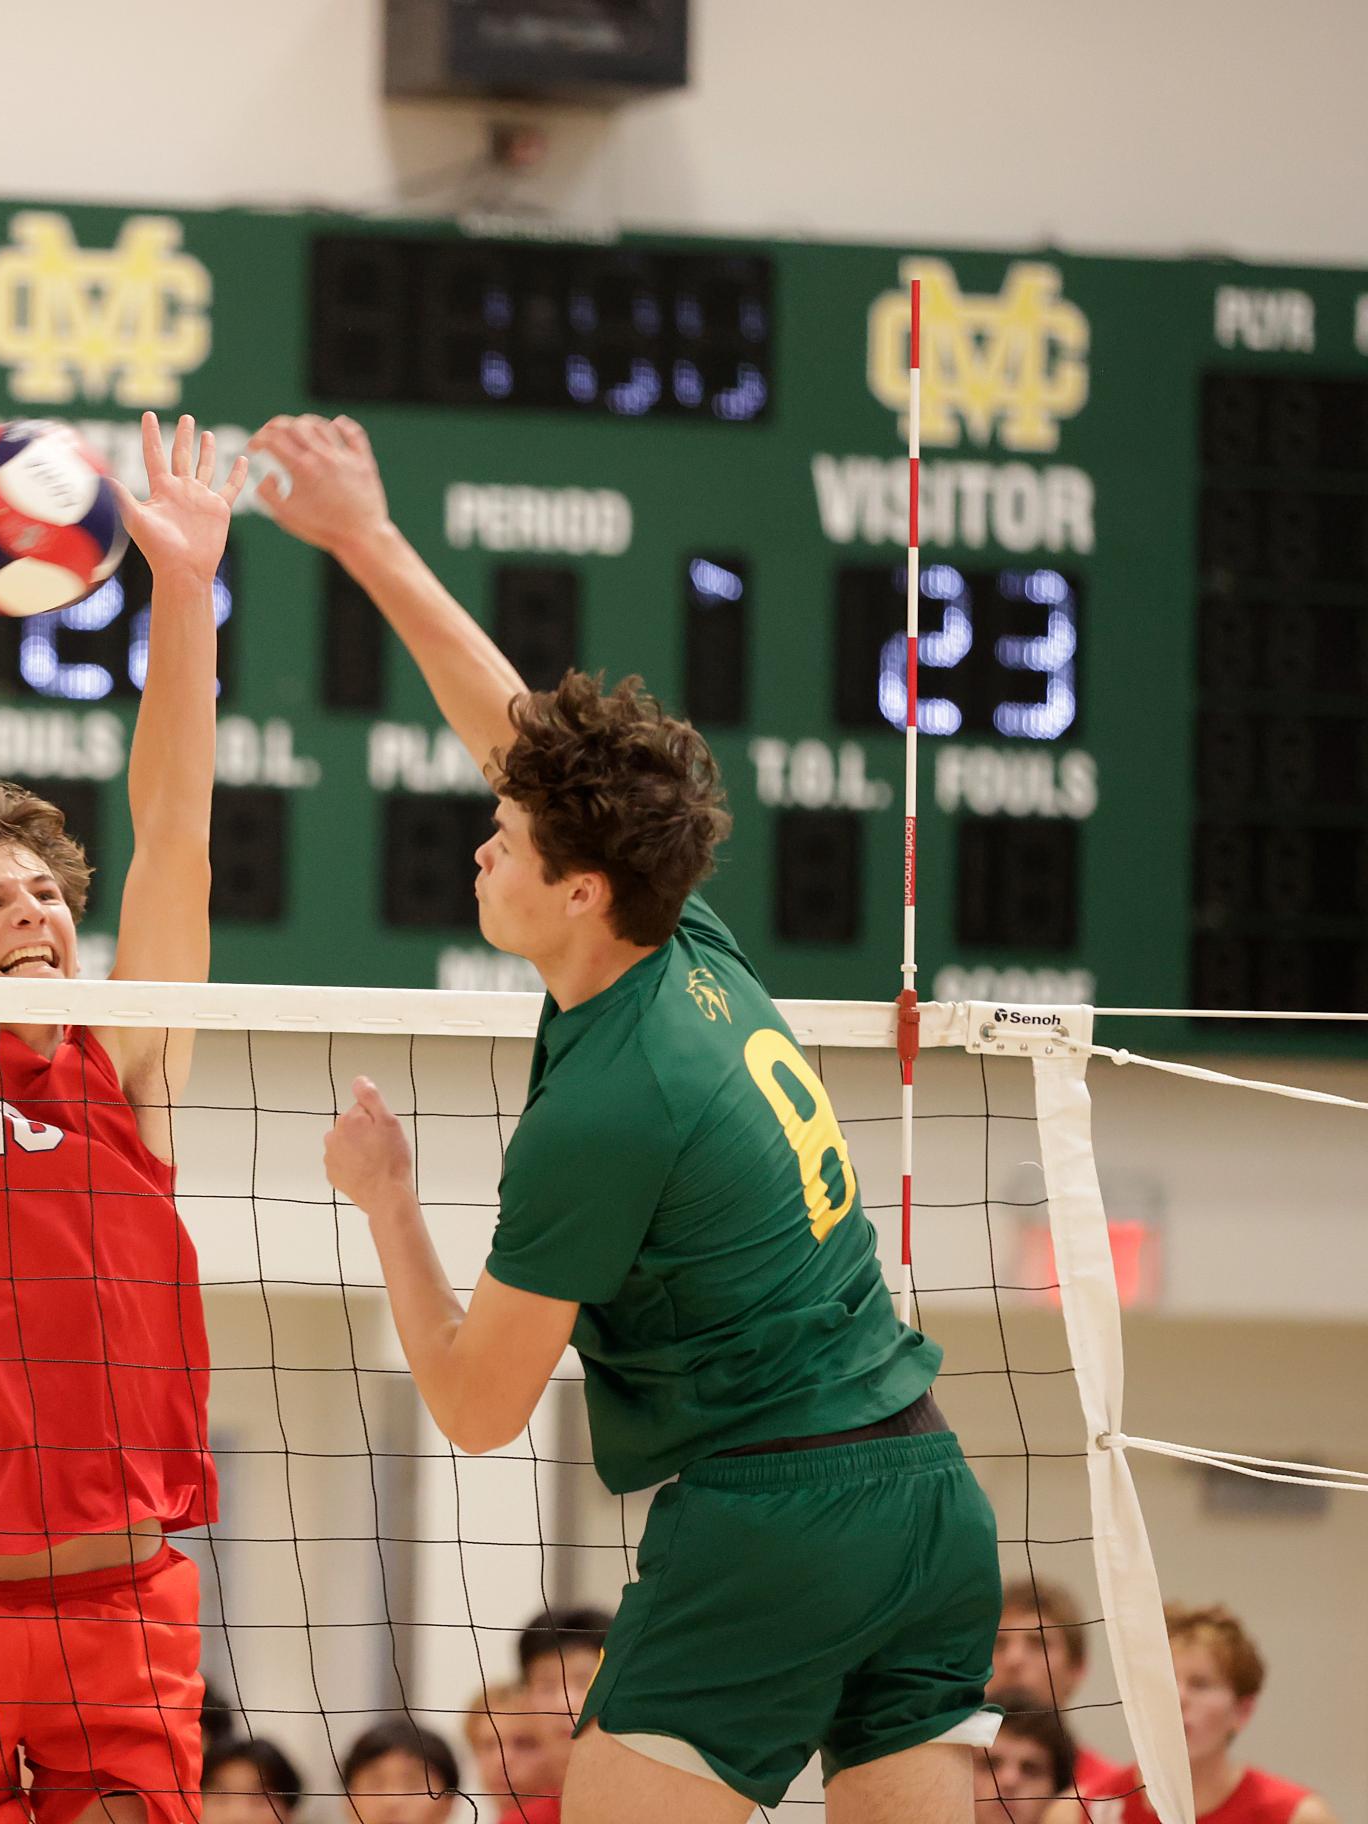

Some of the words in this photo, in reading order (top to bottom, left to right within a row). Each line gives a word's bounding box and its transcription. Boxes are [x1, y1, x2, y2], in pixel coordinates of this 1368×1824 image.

[445, 482, 632, 556] PERIOD
[811, 454, 1095, 555] VISITOR
[878, 564, 1076, 739] 23
[934, 745, 1097, 819] FOULS
[1010, 1011, 1061, 1026] Senoh
[744, 1028, 857, 1244] 8
